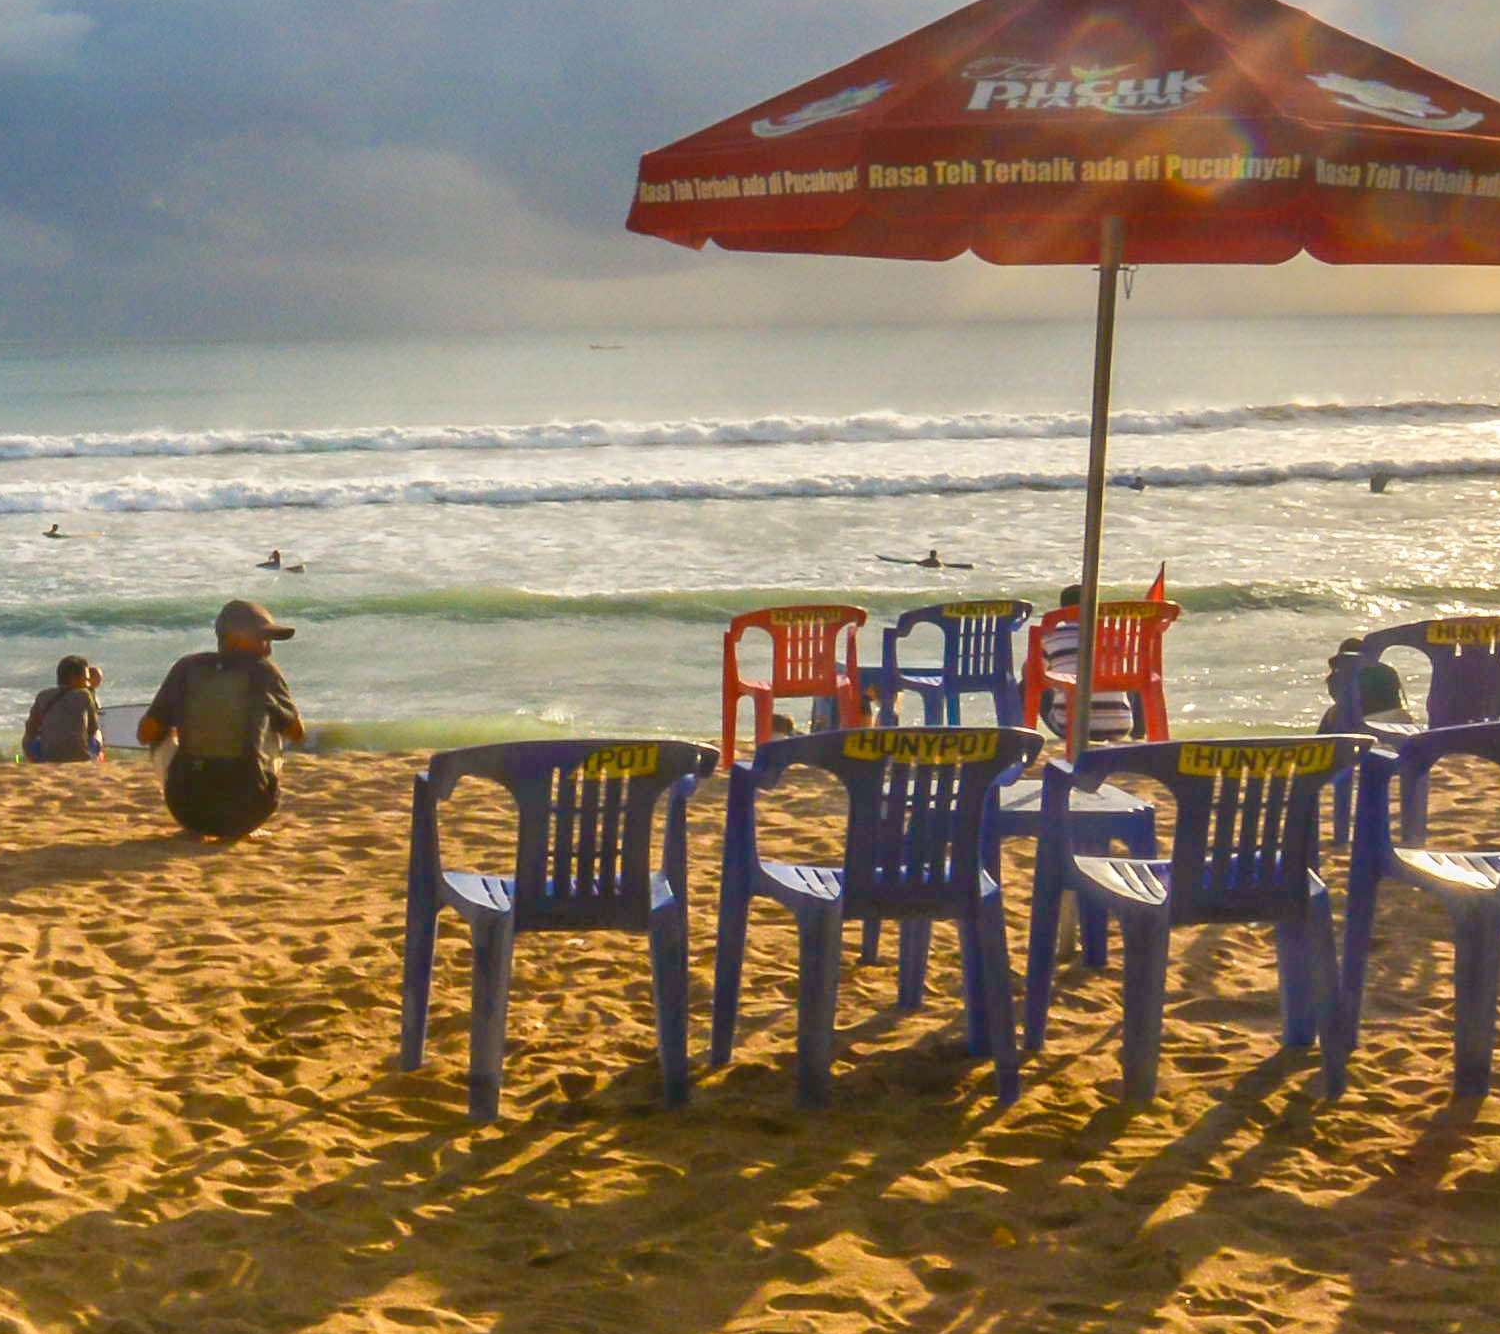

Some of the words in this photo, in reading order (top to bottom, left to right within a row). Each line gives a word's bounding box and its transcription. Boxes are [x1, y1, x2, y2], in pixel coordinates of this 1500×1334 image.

[868, 164, 928, 189] Rasa
[933, 161, 976, 186] Teh
[982, 157, 1074, 184] Terbaik
[1081, 156, 1129, 183] ada
[1133, 155, 1160, 181] di
[1165, 153, 1301, 181] Pucuknya!
[858, 731, 997, 757] HUNYPOT
